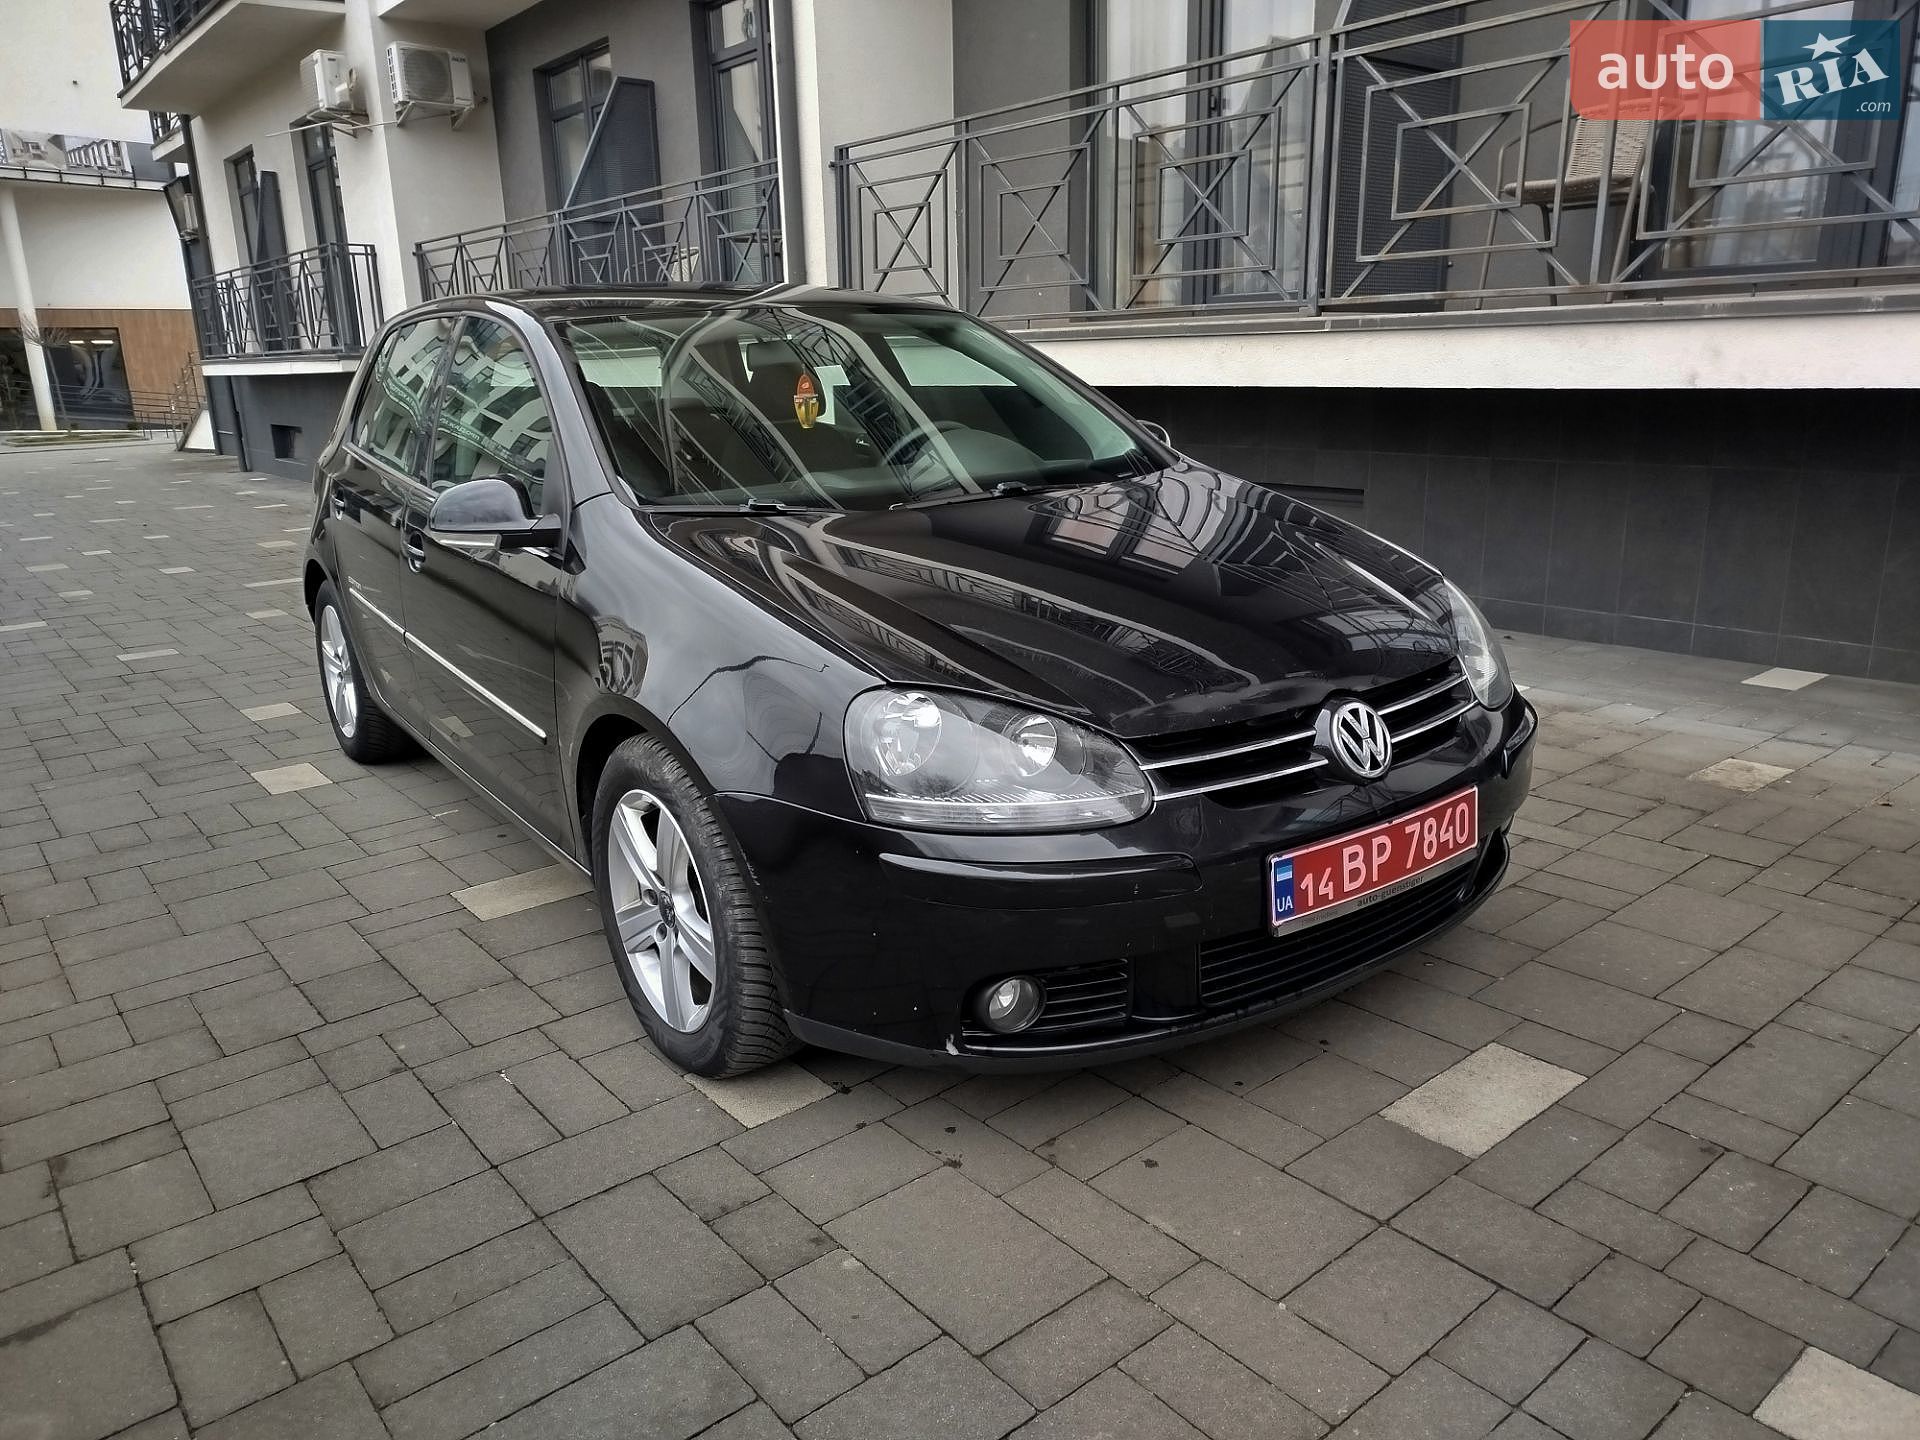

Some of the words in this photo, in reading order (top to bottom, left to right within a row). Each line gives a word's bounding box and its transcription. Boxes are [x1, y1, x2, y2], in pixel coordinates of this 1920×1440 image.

[1300, 867, 1334, 906] 14
[1404, 802, 1469, 869] 7840
[1276, 895, 1293, 913] UA
